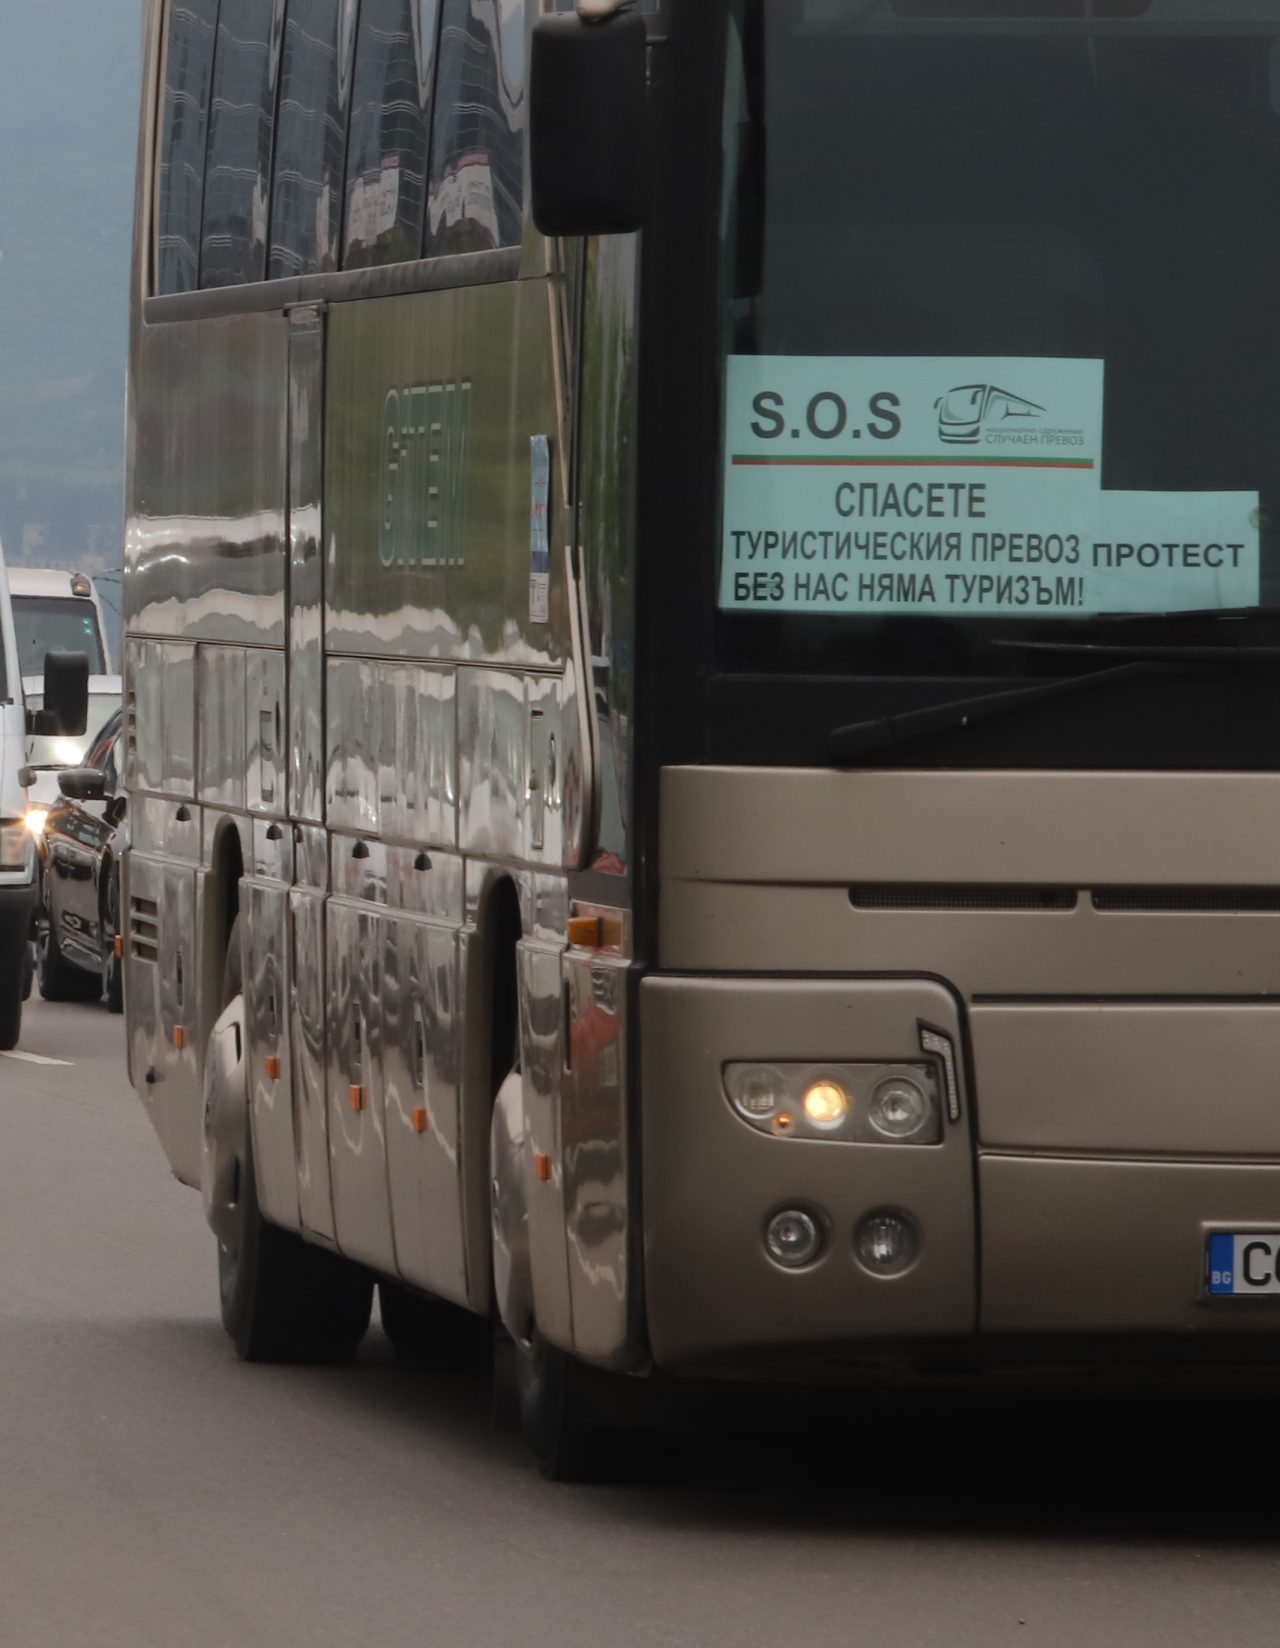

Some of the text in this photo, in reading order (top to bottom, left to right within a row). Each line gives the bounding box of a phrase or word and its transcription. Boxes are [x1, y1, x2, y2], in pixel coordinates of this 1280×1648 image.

[749, 390, 902, 440] S.O.S
[984, 434, 1085, 446] СЛУЧАЕН ПРЕВОЗ
[834, 481, 987, 518] СПАСЕТЕ
[730, 529, 1081, 565] ТУРИСТИЧЕСКИЯ ПРЕВОЗ
[1091, 543, 1244, 568] ПРОТЕСТ
[733, 572, 1084, 607] БЕЗ НАС НЯМА ТУРИЗЪМ!
[1211, 1270, 1232, 1285] BG
[1242, 1241, 1280, 1287] C
